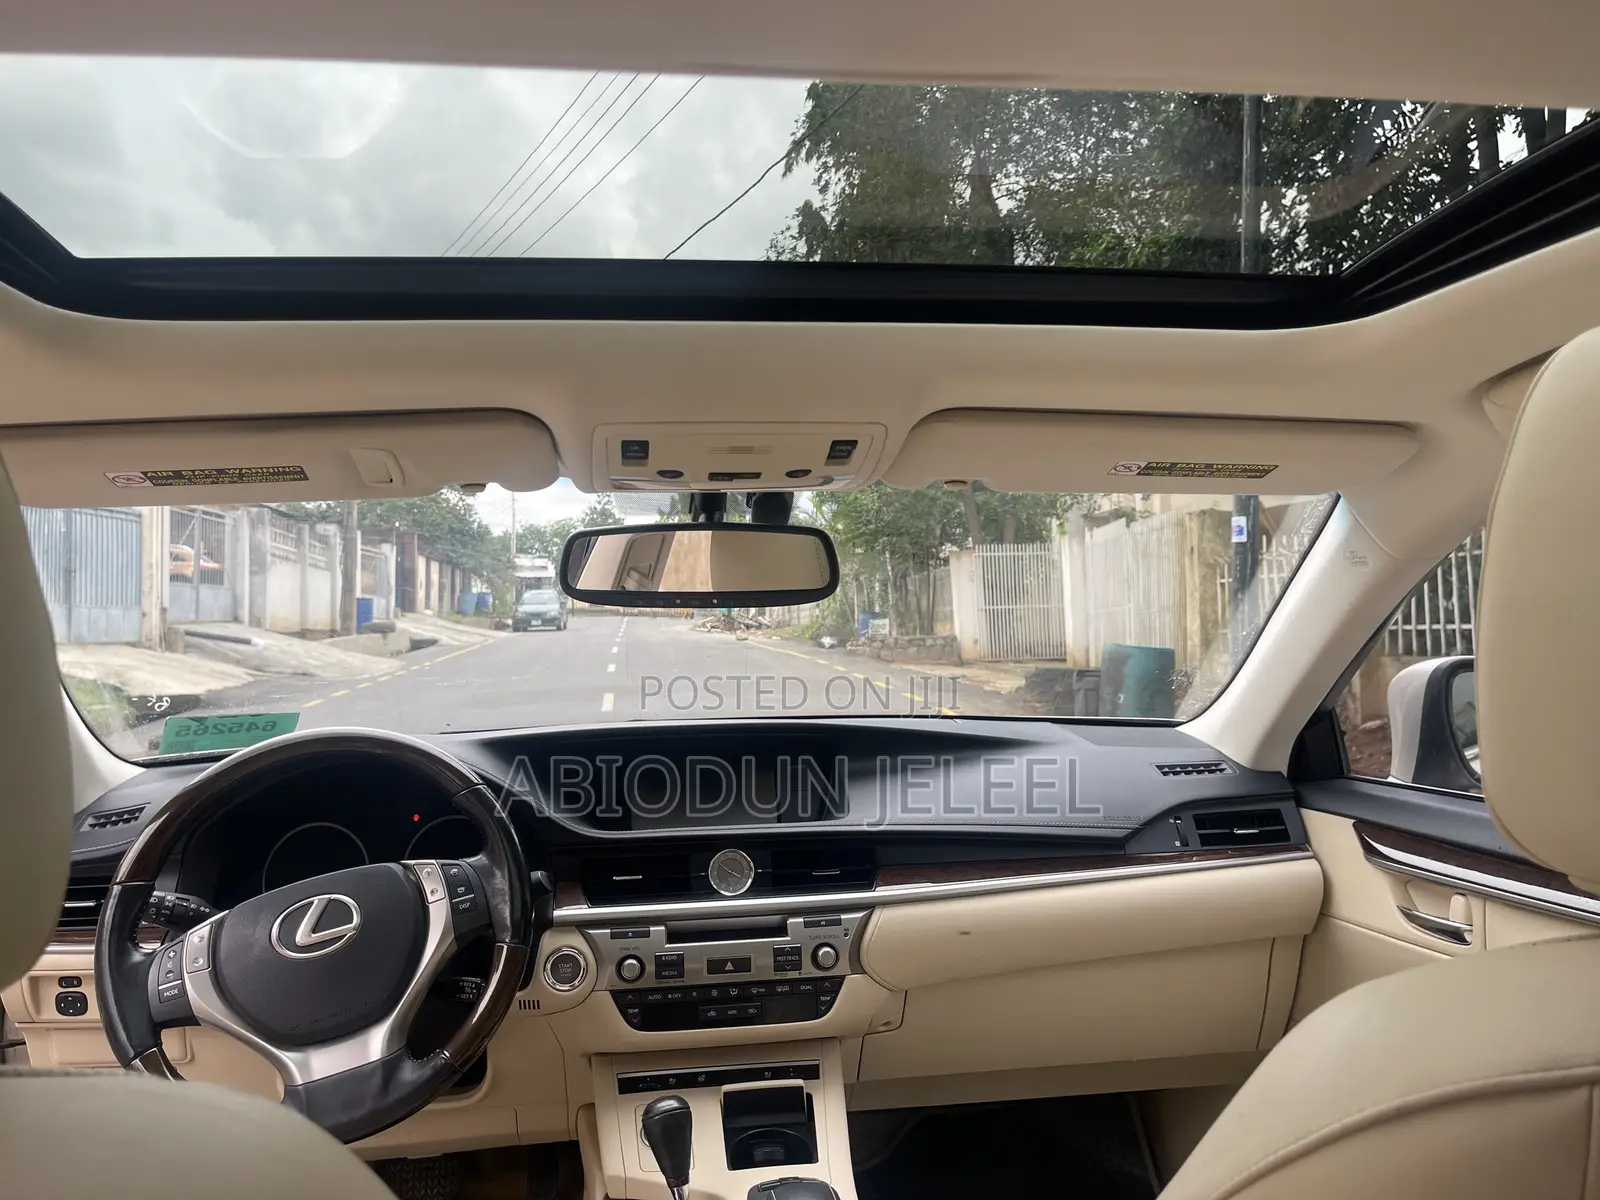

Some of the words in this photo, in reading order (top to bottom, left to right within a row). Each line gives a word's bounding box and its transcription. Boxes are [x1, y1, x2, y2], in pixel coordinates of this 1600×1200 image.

[181, 469, 219, 477] BAG
[224, 465, 302, 475] WARNING
[163, 988, 179, 997] MODE
